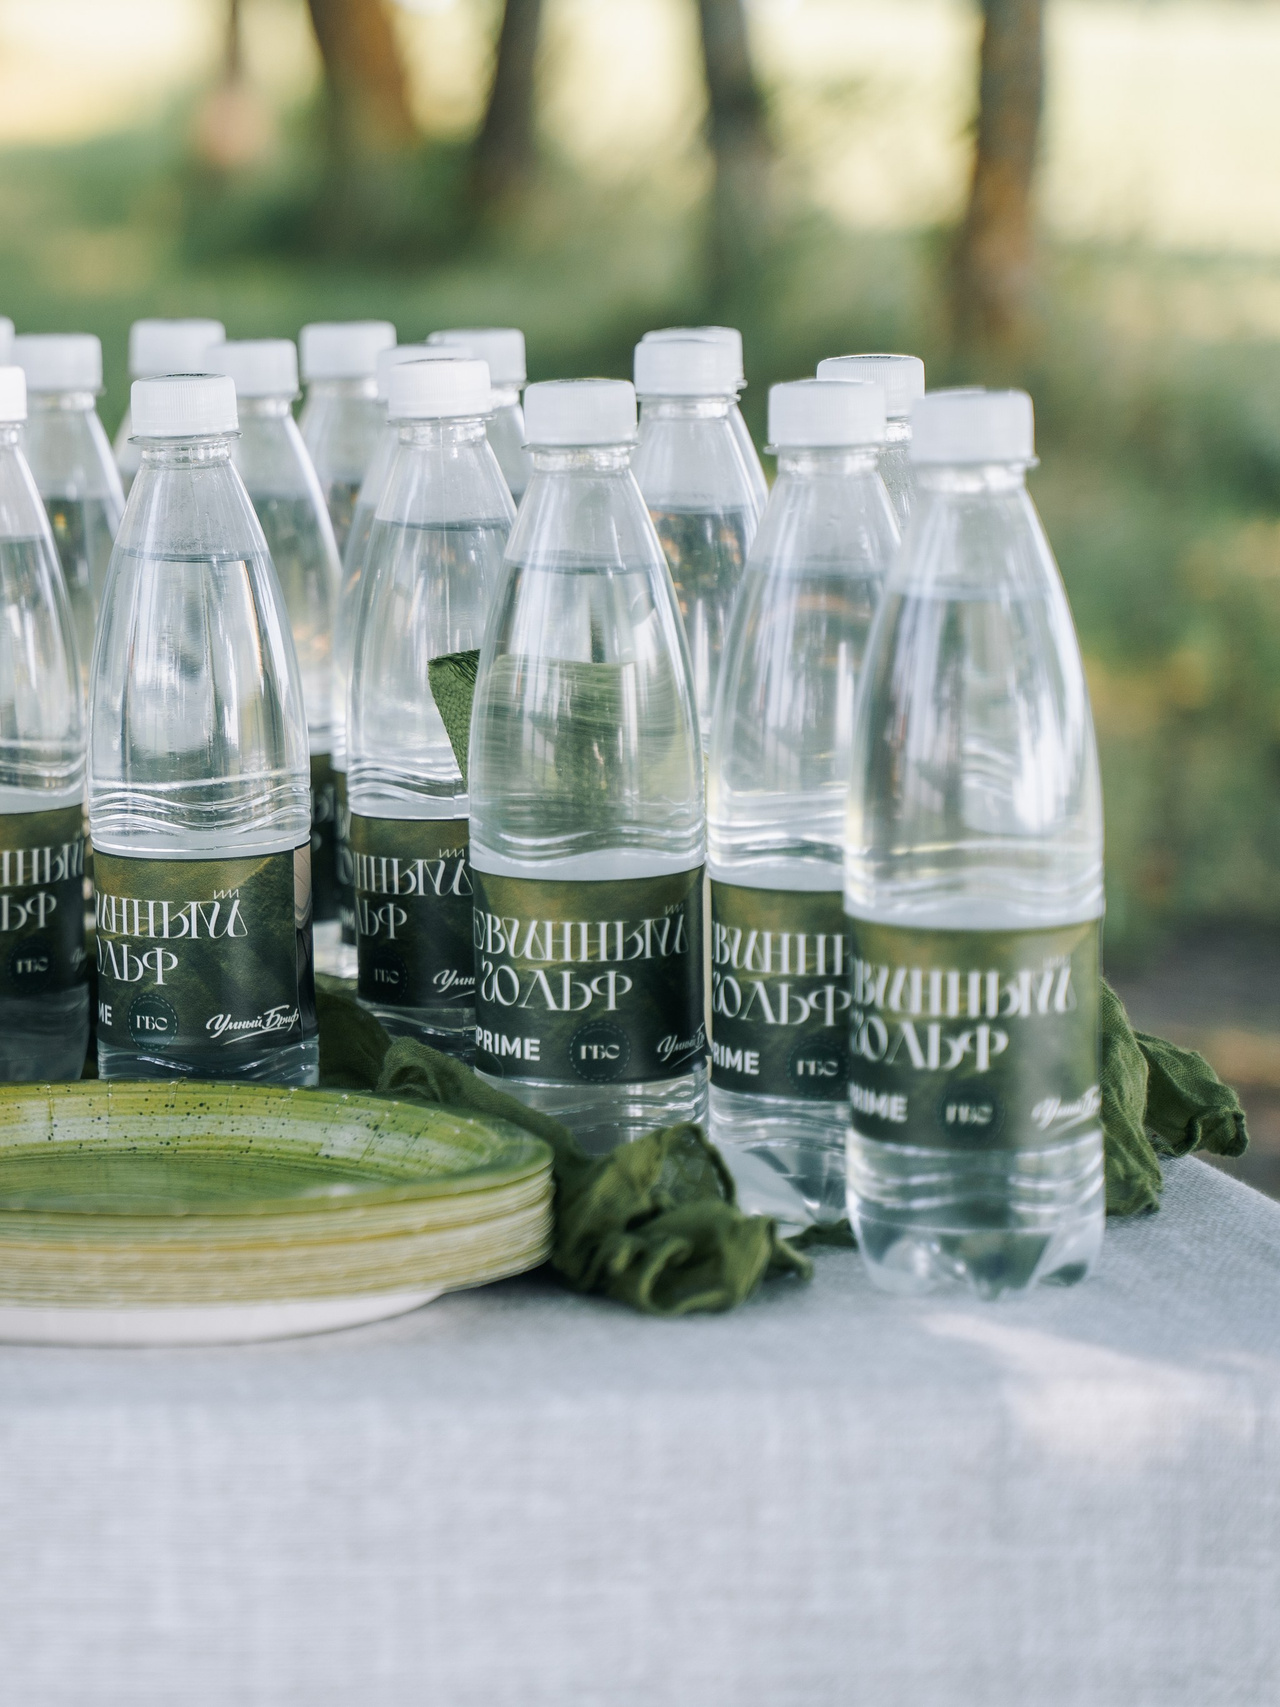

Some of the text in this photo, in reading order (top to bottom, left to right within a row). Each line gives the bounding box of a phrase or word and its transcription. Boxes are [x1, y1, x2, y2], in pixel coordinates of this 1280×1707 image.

[95, 889, 249, 941] ИННЫЙ
[473, 903, 690, 962] ЕВИННЫЙ
[433, 969, 476, 993] Умн
[849, 954, 1078, 1020] ВИННЫЙ
[136, 1014, 169, 1032] ГБС
[205, 1004, 300, 1039] Умный Бриф
[475, 1025, 541, 1062] PRIME
[580, 1044, 620, 1061] ГБС
[712, 1041, 760, 1076] RIME
